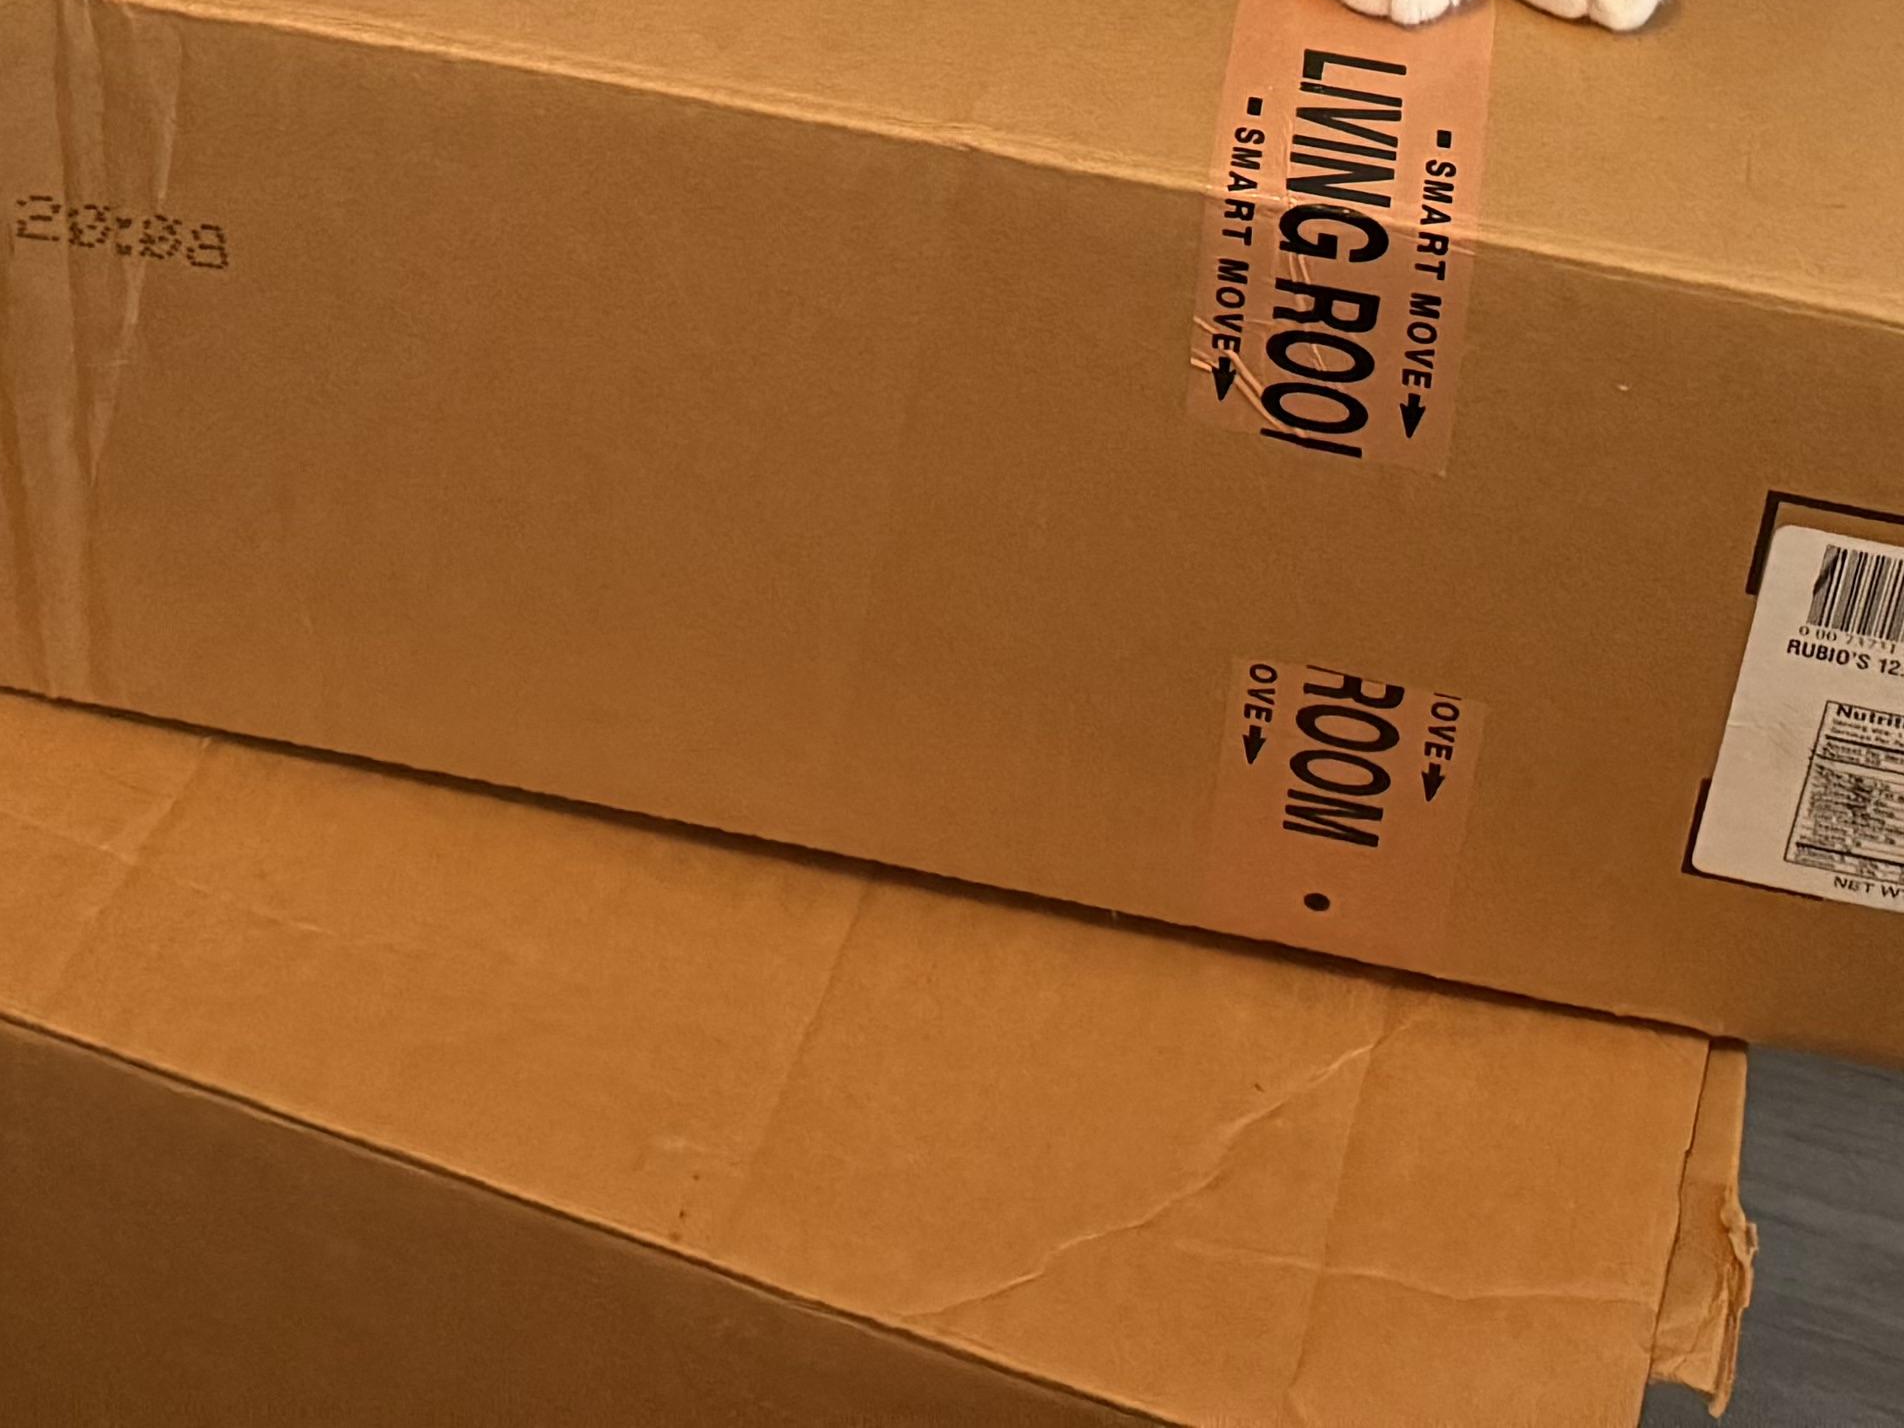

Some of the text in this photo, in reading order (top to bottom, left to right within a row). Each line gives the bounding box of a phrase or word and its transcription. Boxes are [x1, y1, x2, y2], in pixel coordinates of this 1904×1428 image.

[1213, 125, 1267, 356] SMART MOVE
[1276, 47, 1408, 265] LIVING
[1399, 150, 1457, 391] SMART MOVE
[1423, 691, 1463, 761] OVE
[1786, 638, 1872, 671] RUBIO'S
[1282, 664, 1405, 848] ROOM
[1833, 874, 1874, 896] NET
